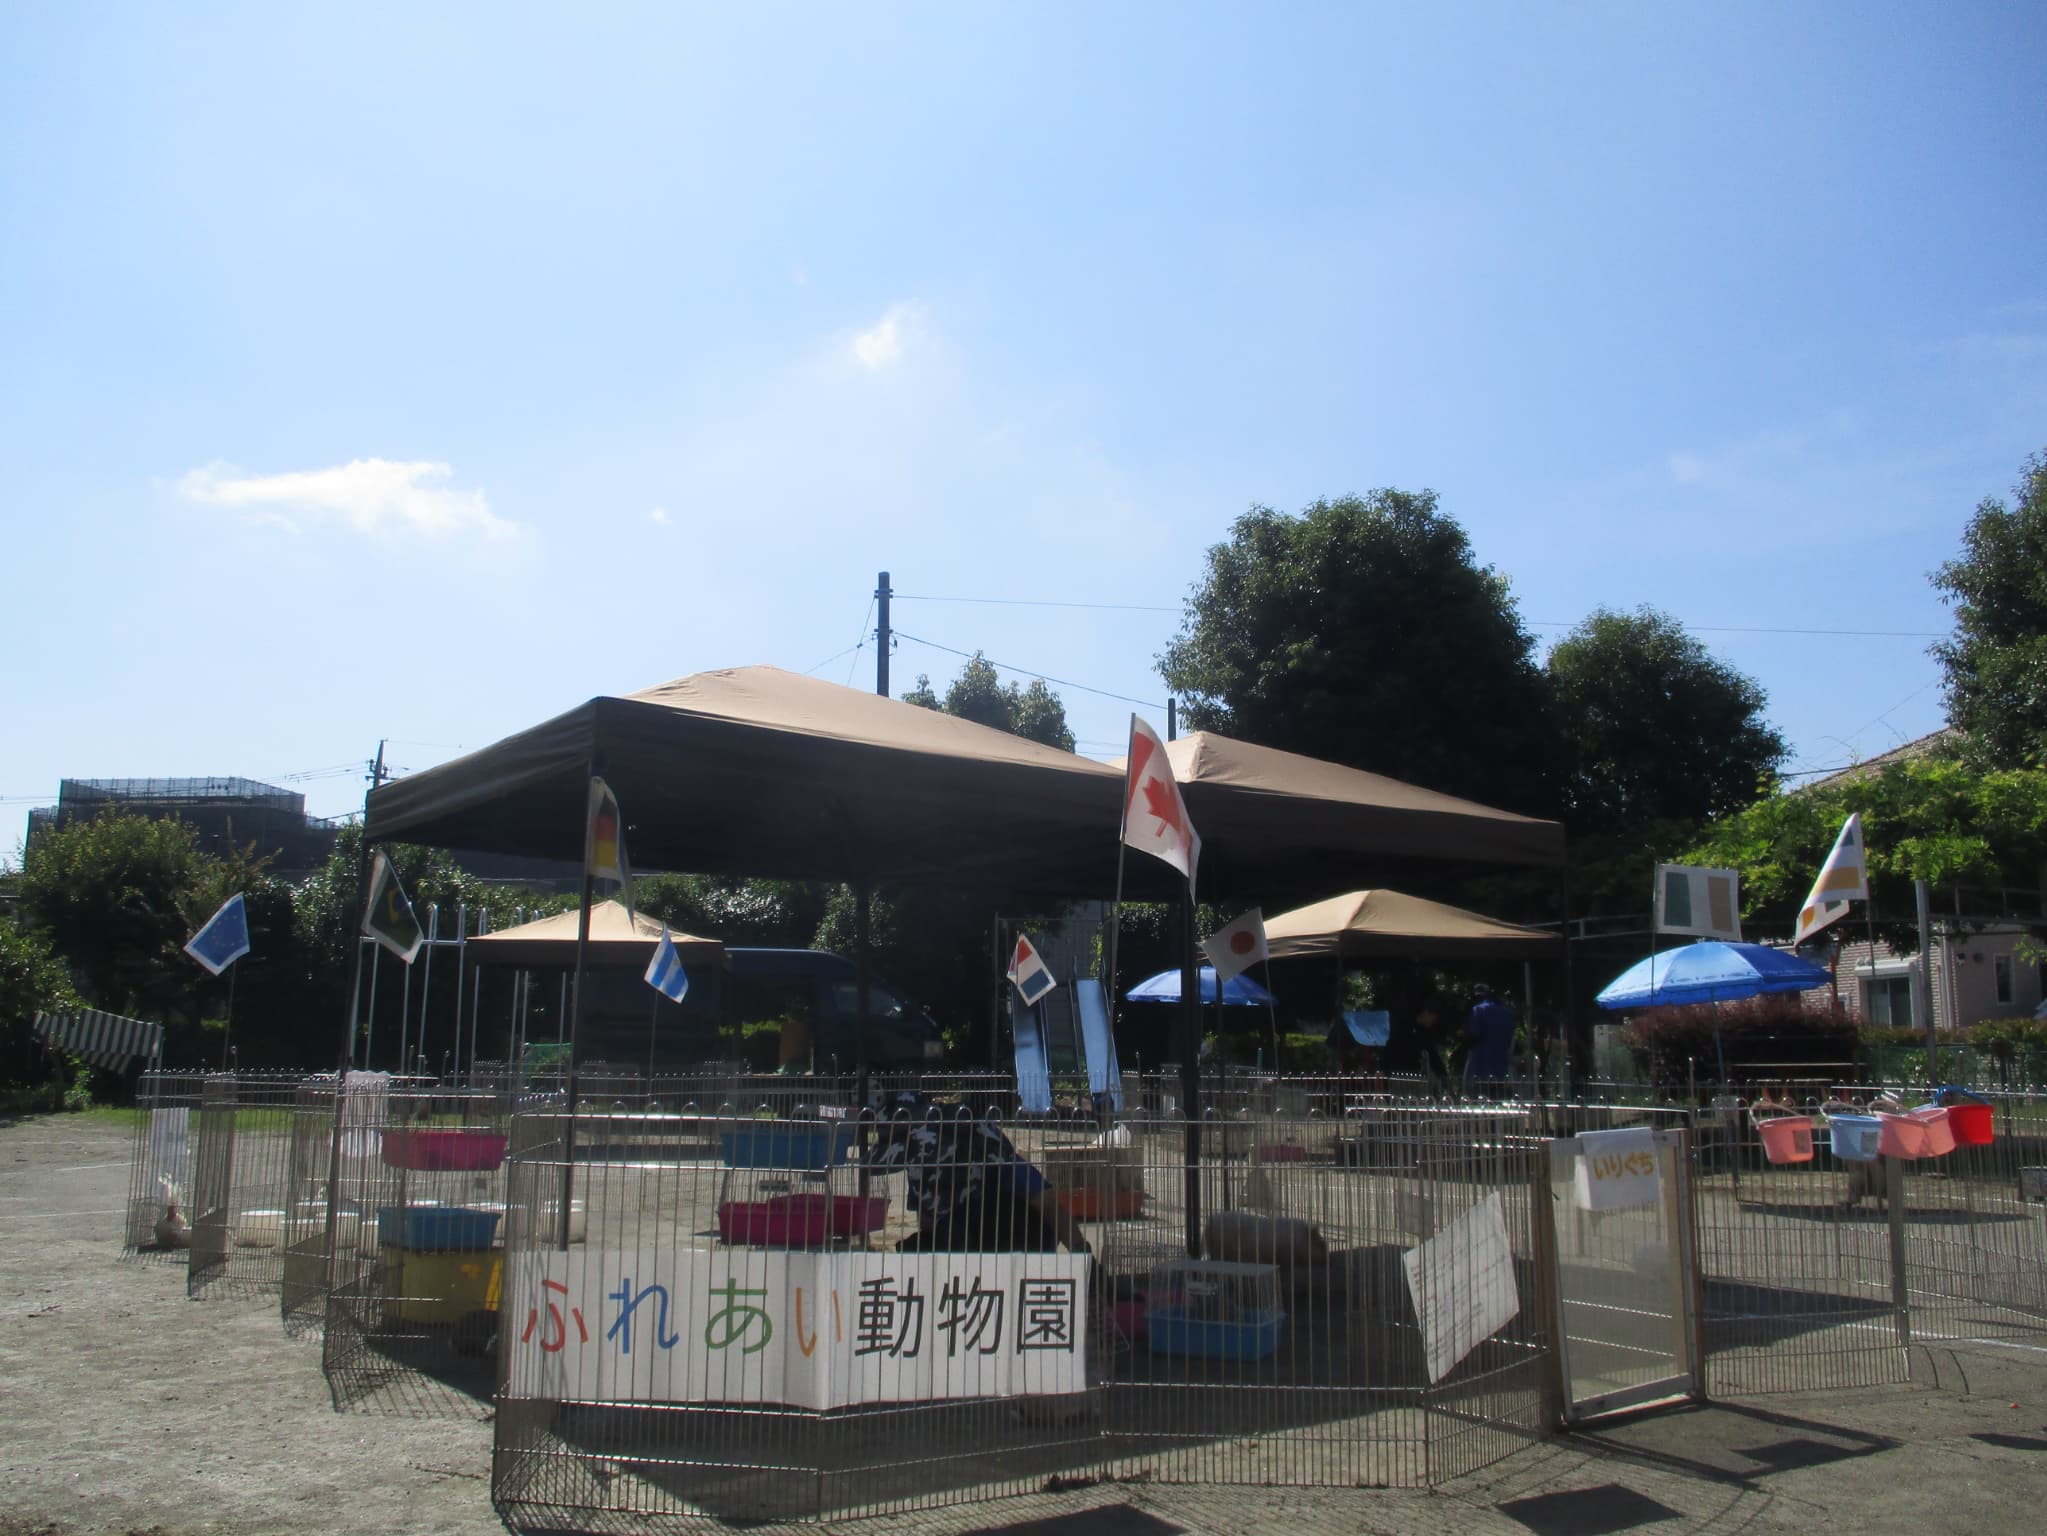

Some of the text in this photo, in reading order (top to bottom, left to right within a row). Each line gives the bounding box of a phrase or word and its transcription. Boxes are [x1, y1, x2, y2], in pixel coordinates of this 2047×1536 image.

[1592, 1151, 1655, 1181] いりぐち
[521, 1276, 1077, 1358] ふれあい動物園
